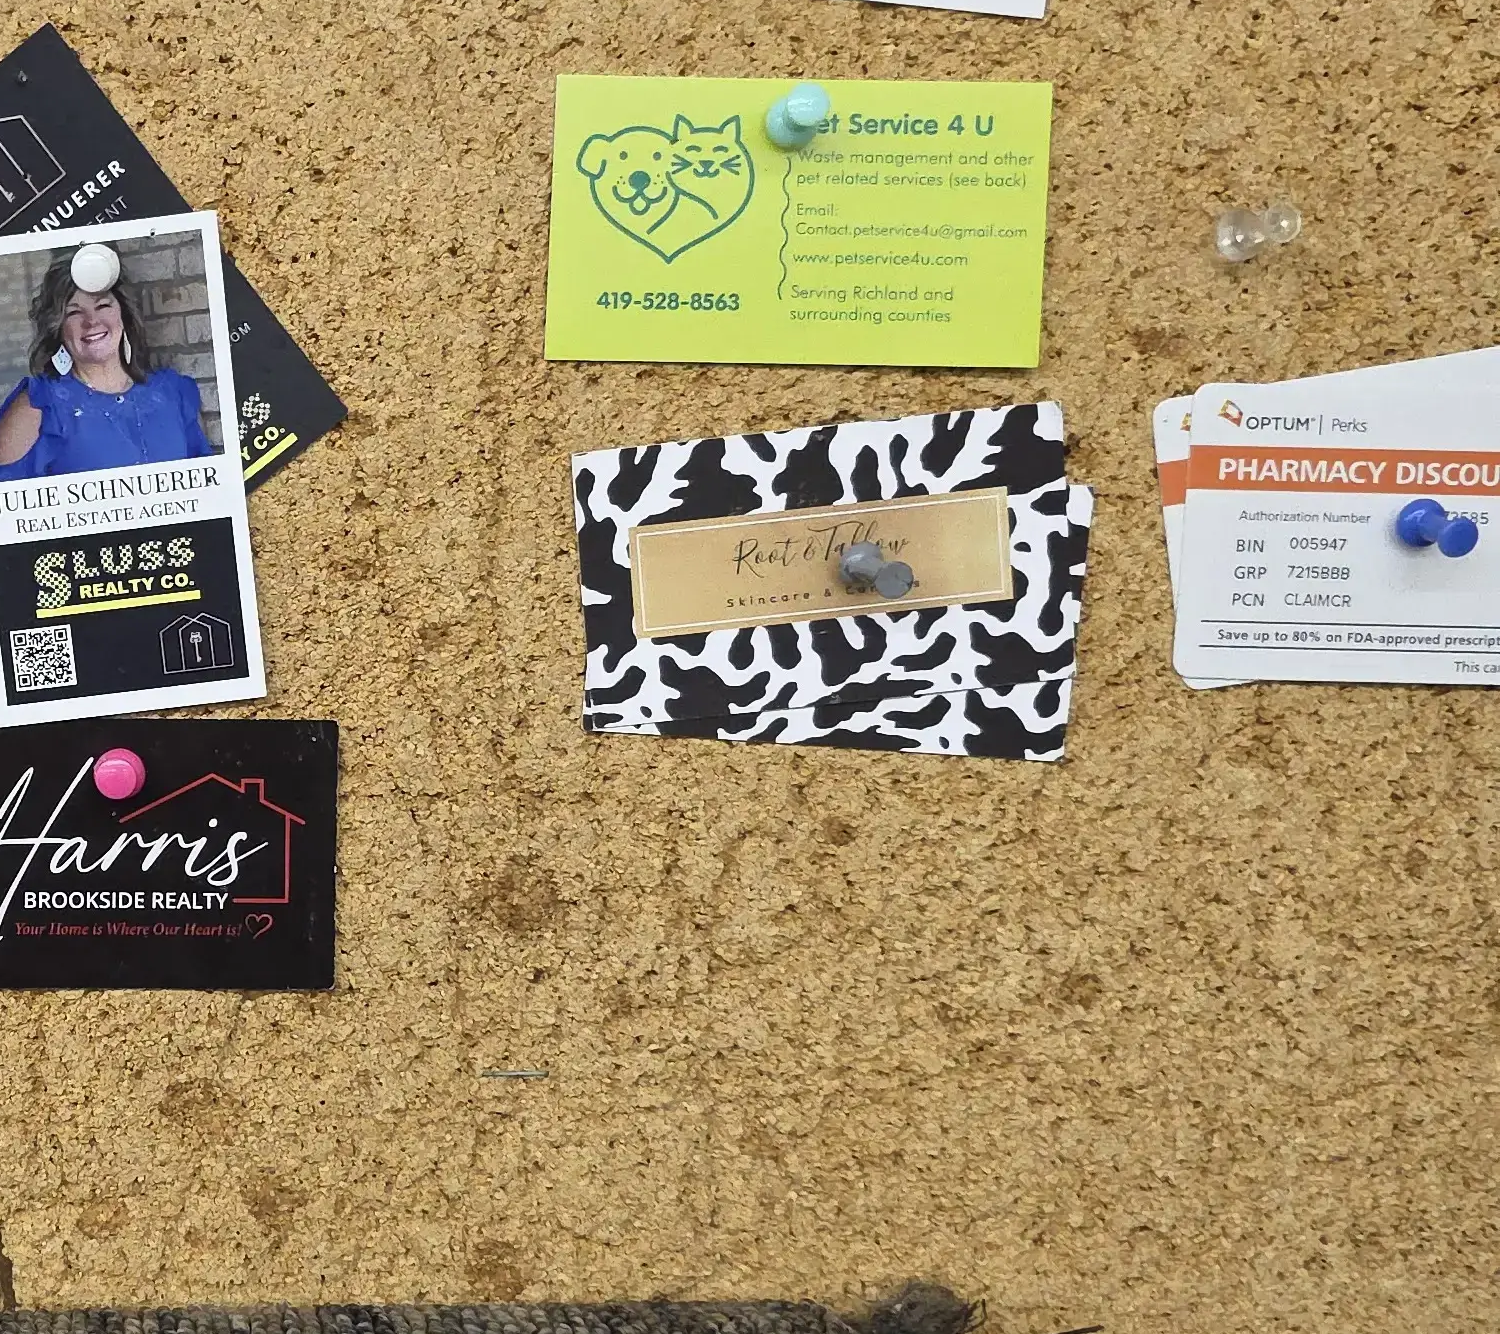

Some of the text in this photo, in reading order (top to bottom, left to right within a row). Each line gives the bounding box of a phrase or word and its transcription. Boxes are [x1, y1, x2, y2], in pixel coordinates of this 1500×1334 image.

[849, 114, 994, 137] Service 4 U
[793, 250, 968, 268] www.petservice4u.com
[597, 291, 740, 312] 419-528-8563
[1219, 458, 1387, 484] PHARMACY
[67, 467, 220, 506] SCHNUERER
[15, 498, 200, 535] REAL ESTATE AGENT
[1236, 537, 1347, 553] BIN 005947
[79, 573, 195, 598] REALTY CO.
[1232, 593, 1352, 608] PCN CLAIMCR
[24, 891, 229, 910] BROOKSIDE REALTY
